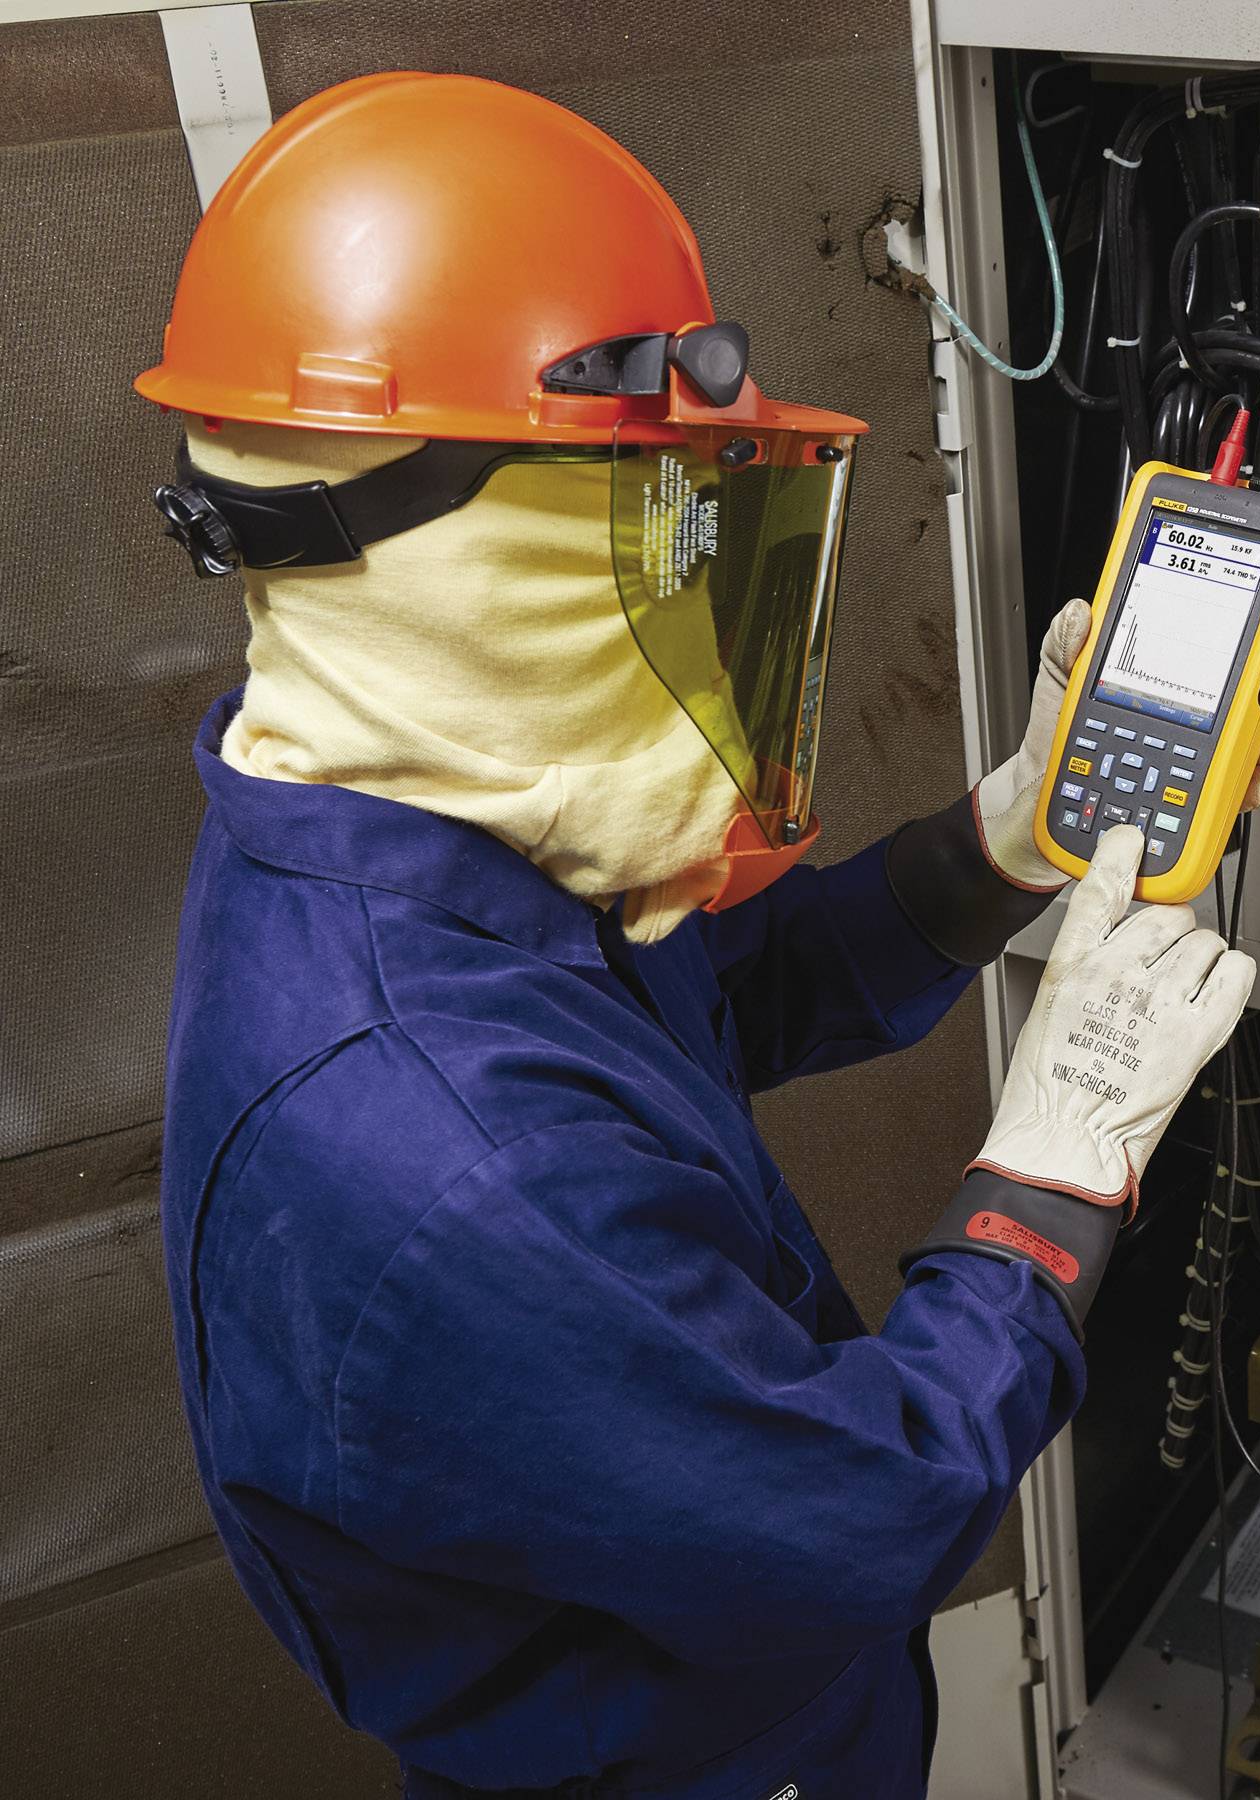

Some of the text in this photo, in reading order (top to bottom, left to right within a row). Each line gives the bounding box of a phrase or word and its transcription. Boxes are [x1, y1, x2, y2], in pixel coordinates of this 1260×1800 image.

[1158, 500, 1185, 511] FLUKE
[704, 500, 718, 556] SALISBURY
[1168, 530, 1204, 549] 60.02
[1231, 544, 1252, 555] 15.9 KF
[1168, 554, 1196, 571] 3.61
[1223, 567, 1235, 576] 74.4
[1237, 570, 1248, 579] THD
[1070, 765, 1086, 773] METER
[1072, 759, 1088, 768] SCOPE
[1165, 791, 1183, 801] RECORD
[1111, 807, 1123, 815] TIME
[1105, 992, 1120, 1005] 10
[1082, 1000, 1117, 1020] CLASS
[1082, 1019, 1139, 1051] PROTECTOR
[1068, 1031, 1142, 1072] WEAR OVER SIZE
[980, 1216, 990, 1228] 9
[1011, 1224, 1062, 1256] SALISBURY
